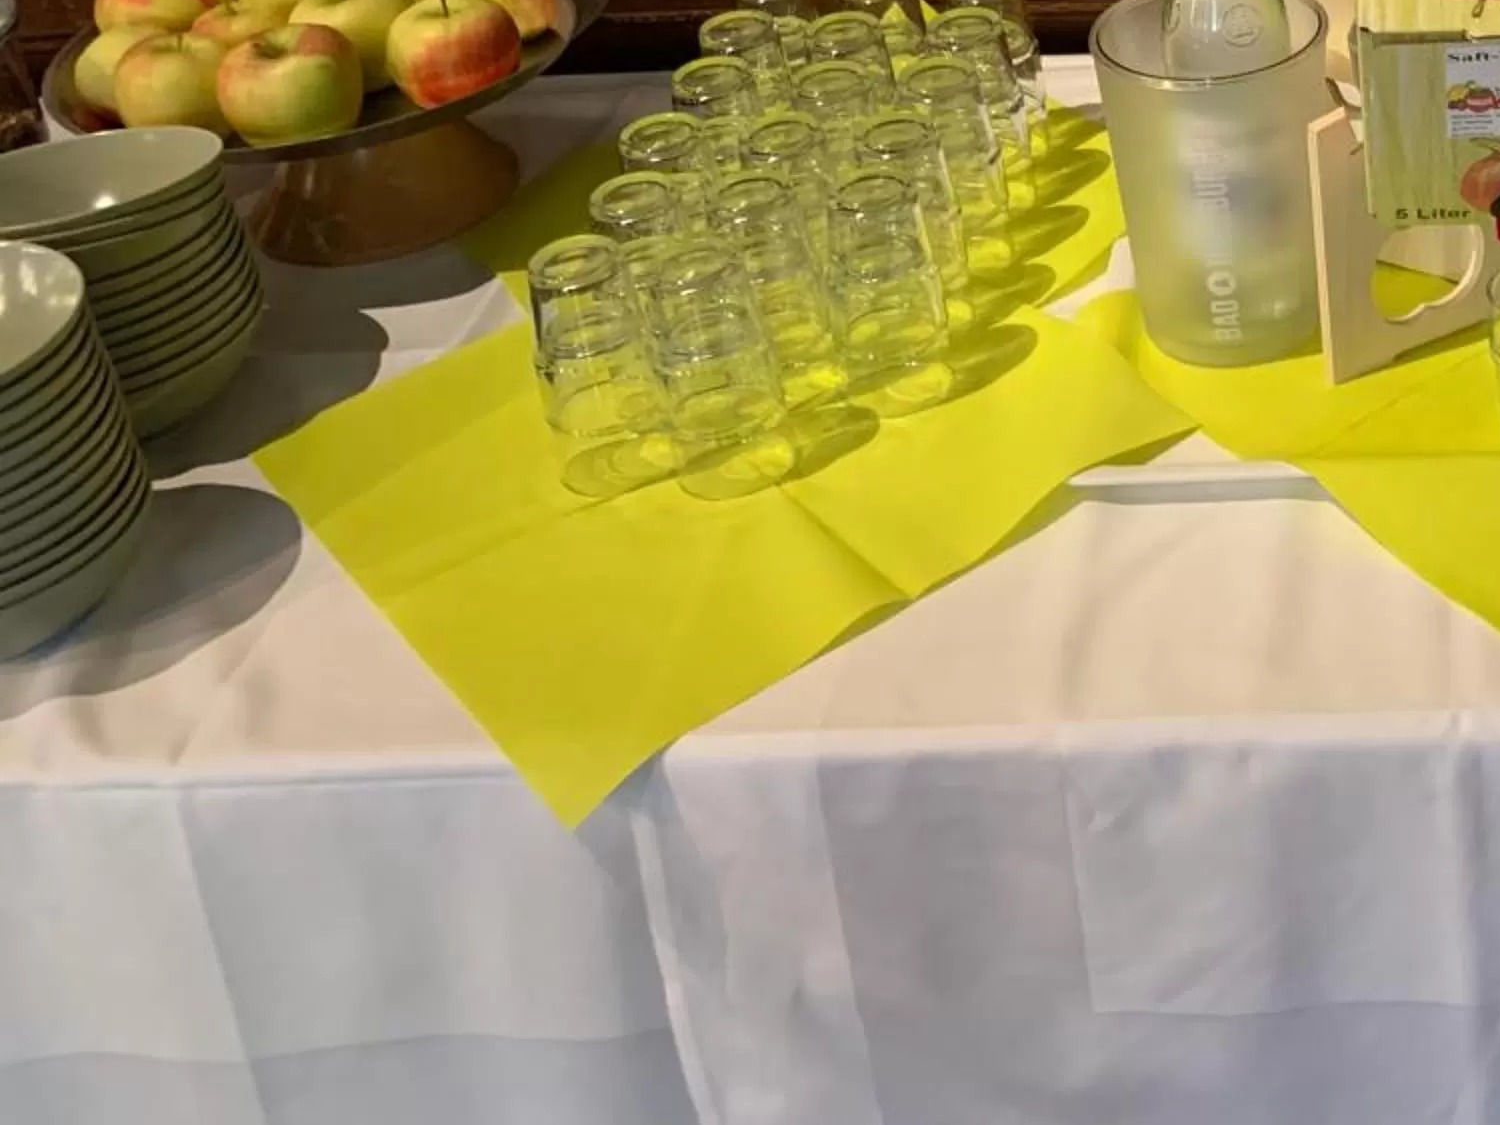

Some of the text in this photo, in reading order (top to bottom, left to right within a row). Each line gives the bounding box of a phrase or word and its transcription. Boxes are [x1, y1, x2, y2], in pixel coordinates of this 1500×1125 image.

[1396, 207, 1472, 220] 5 Liter
[1211, 299, 1242, 343] BAD
